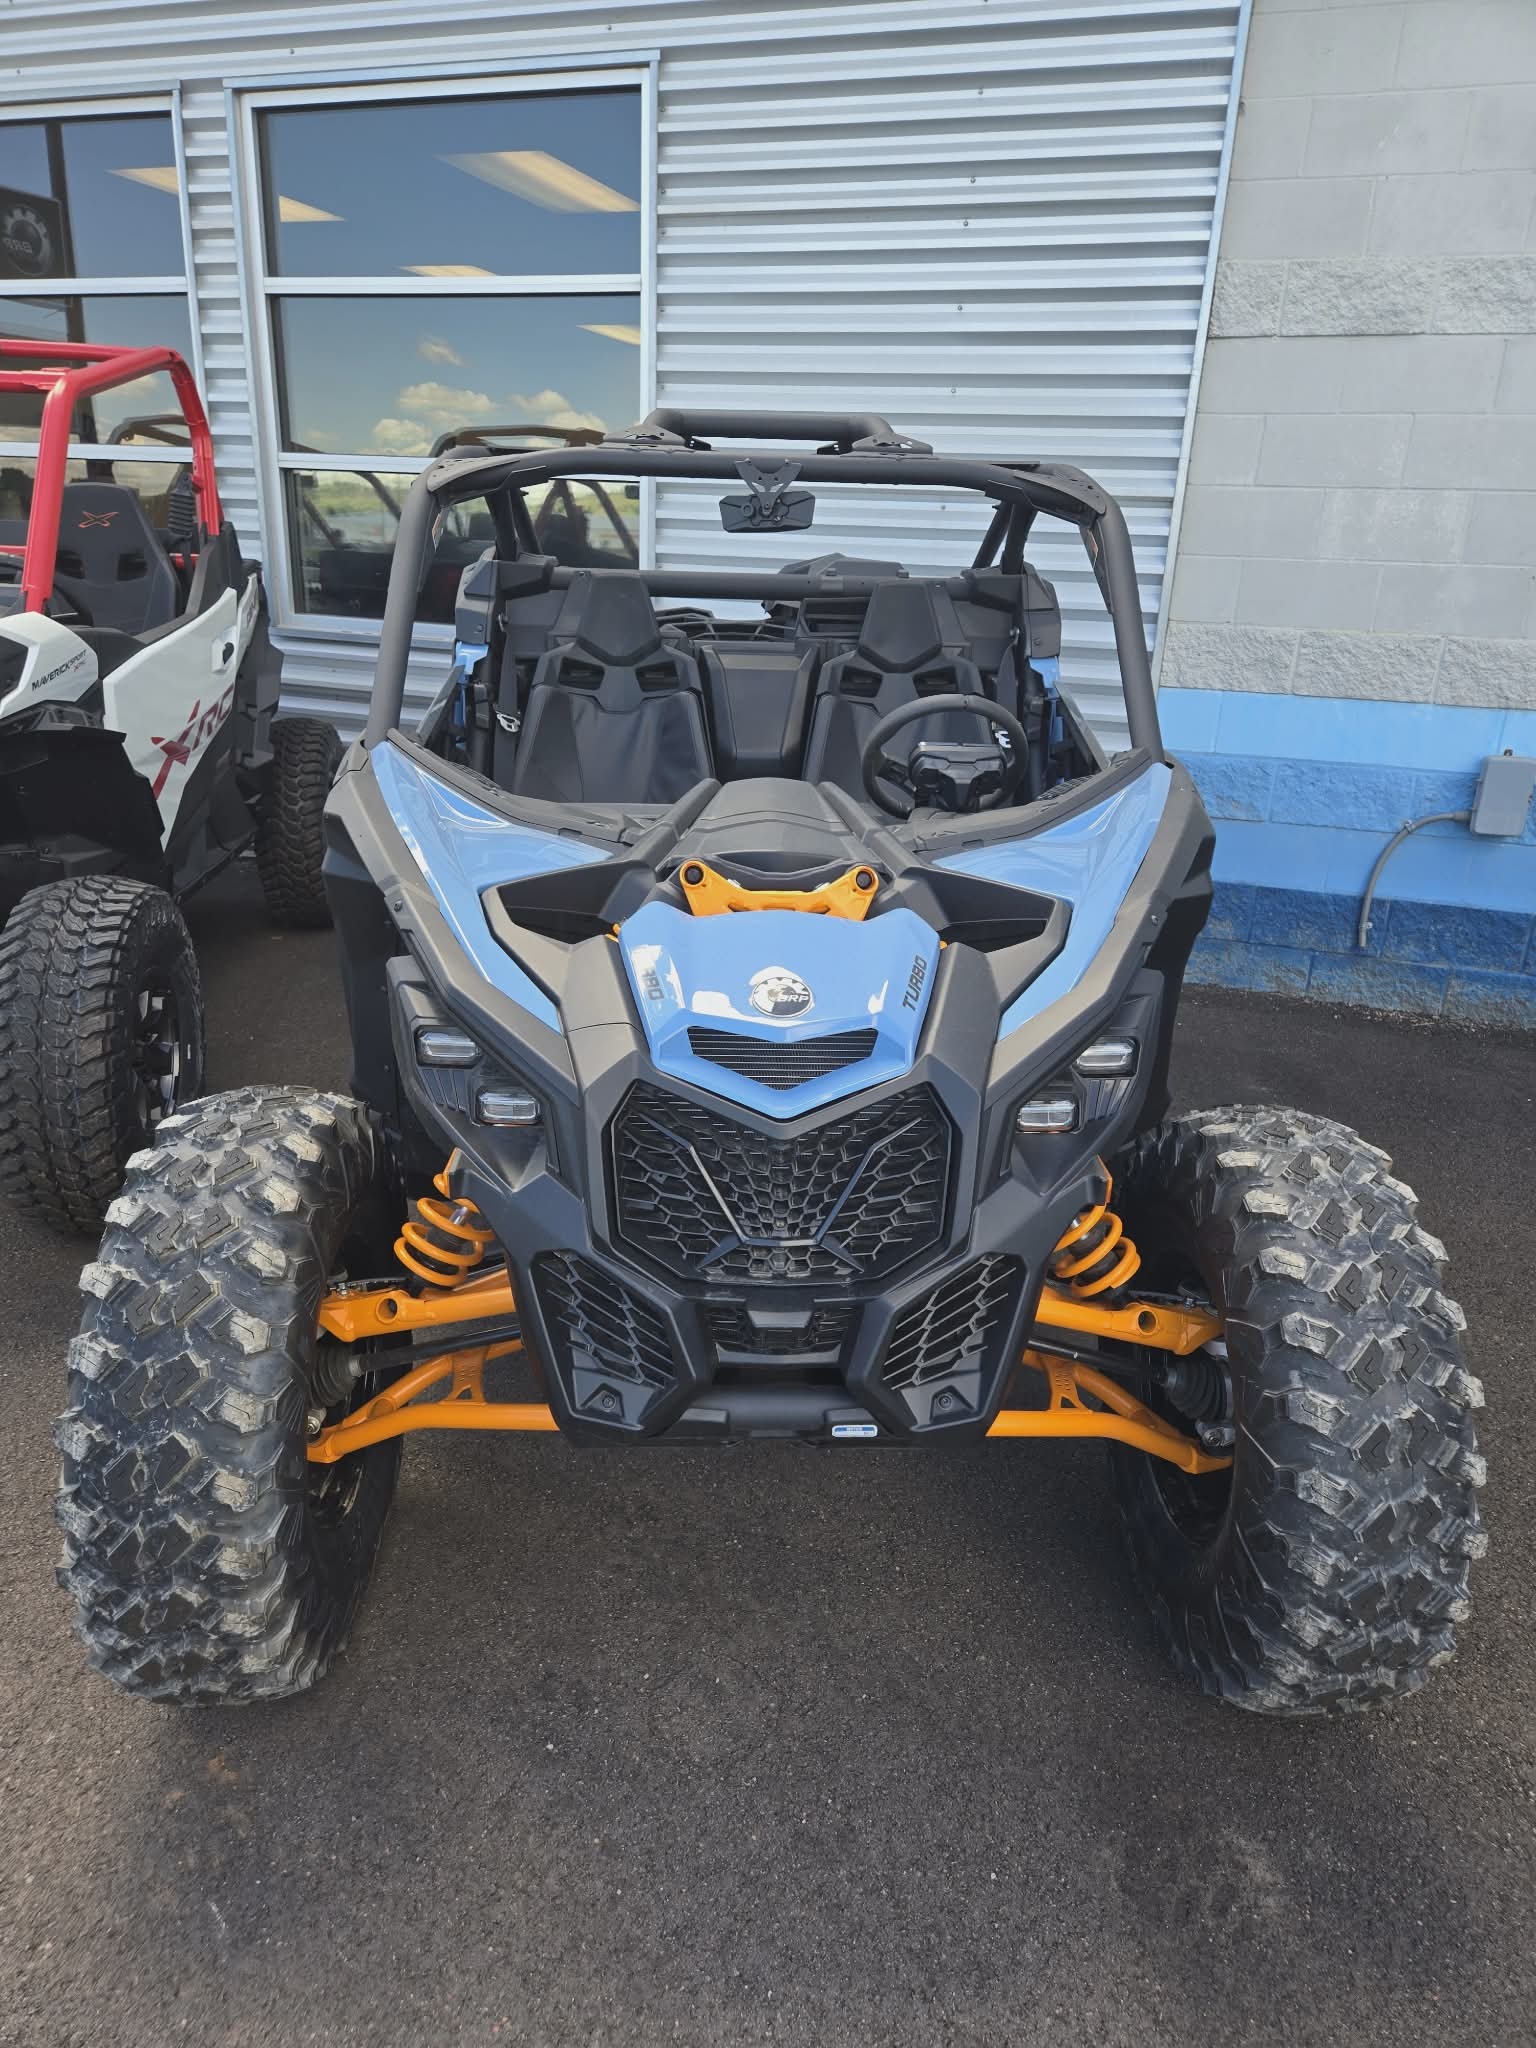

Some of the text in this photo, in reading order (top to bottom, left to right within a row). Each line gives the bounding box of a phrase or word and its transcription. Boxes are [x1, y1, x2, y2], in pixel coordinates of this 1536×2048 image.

[31, 660, 71, 691] MAVERICK
[775, 993, 810, 1003] BRP
[902, 954, 928, 1012] TURBO
